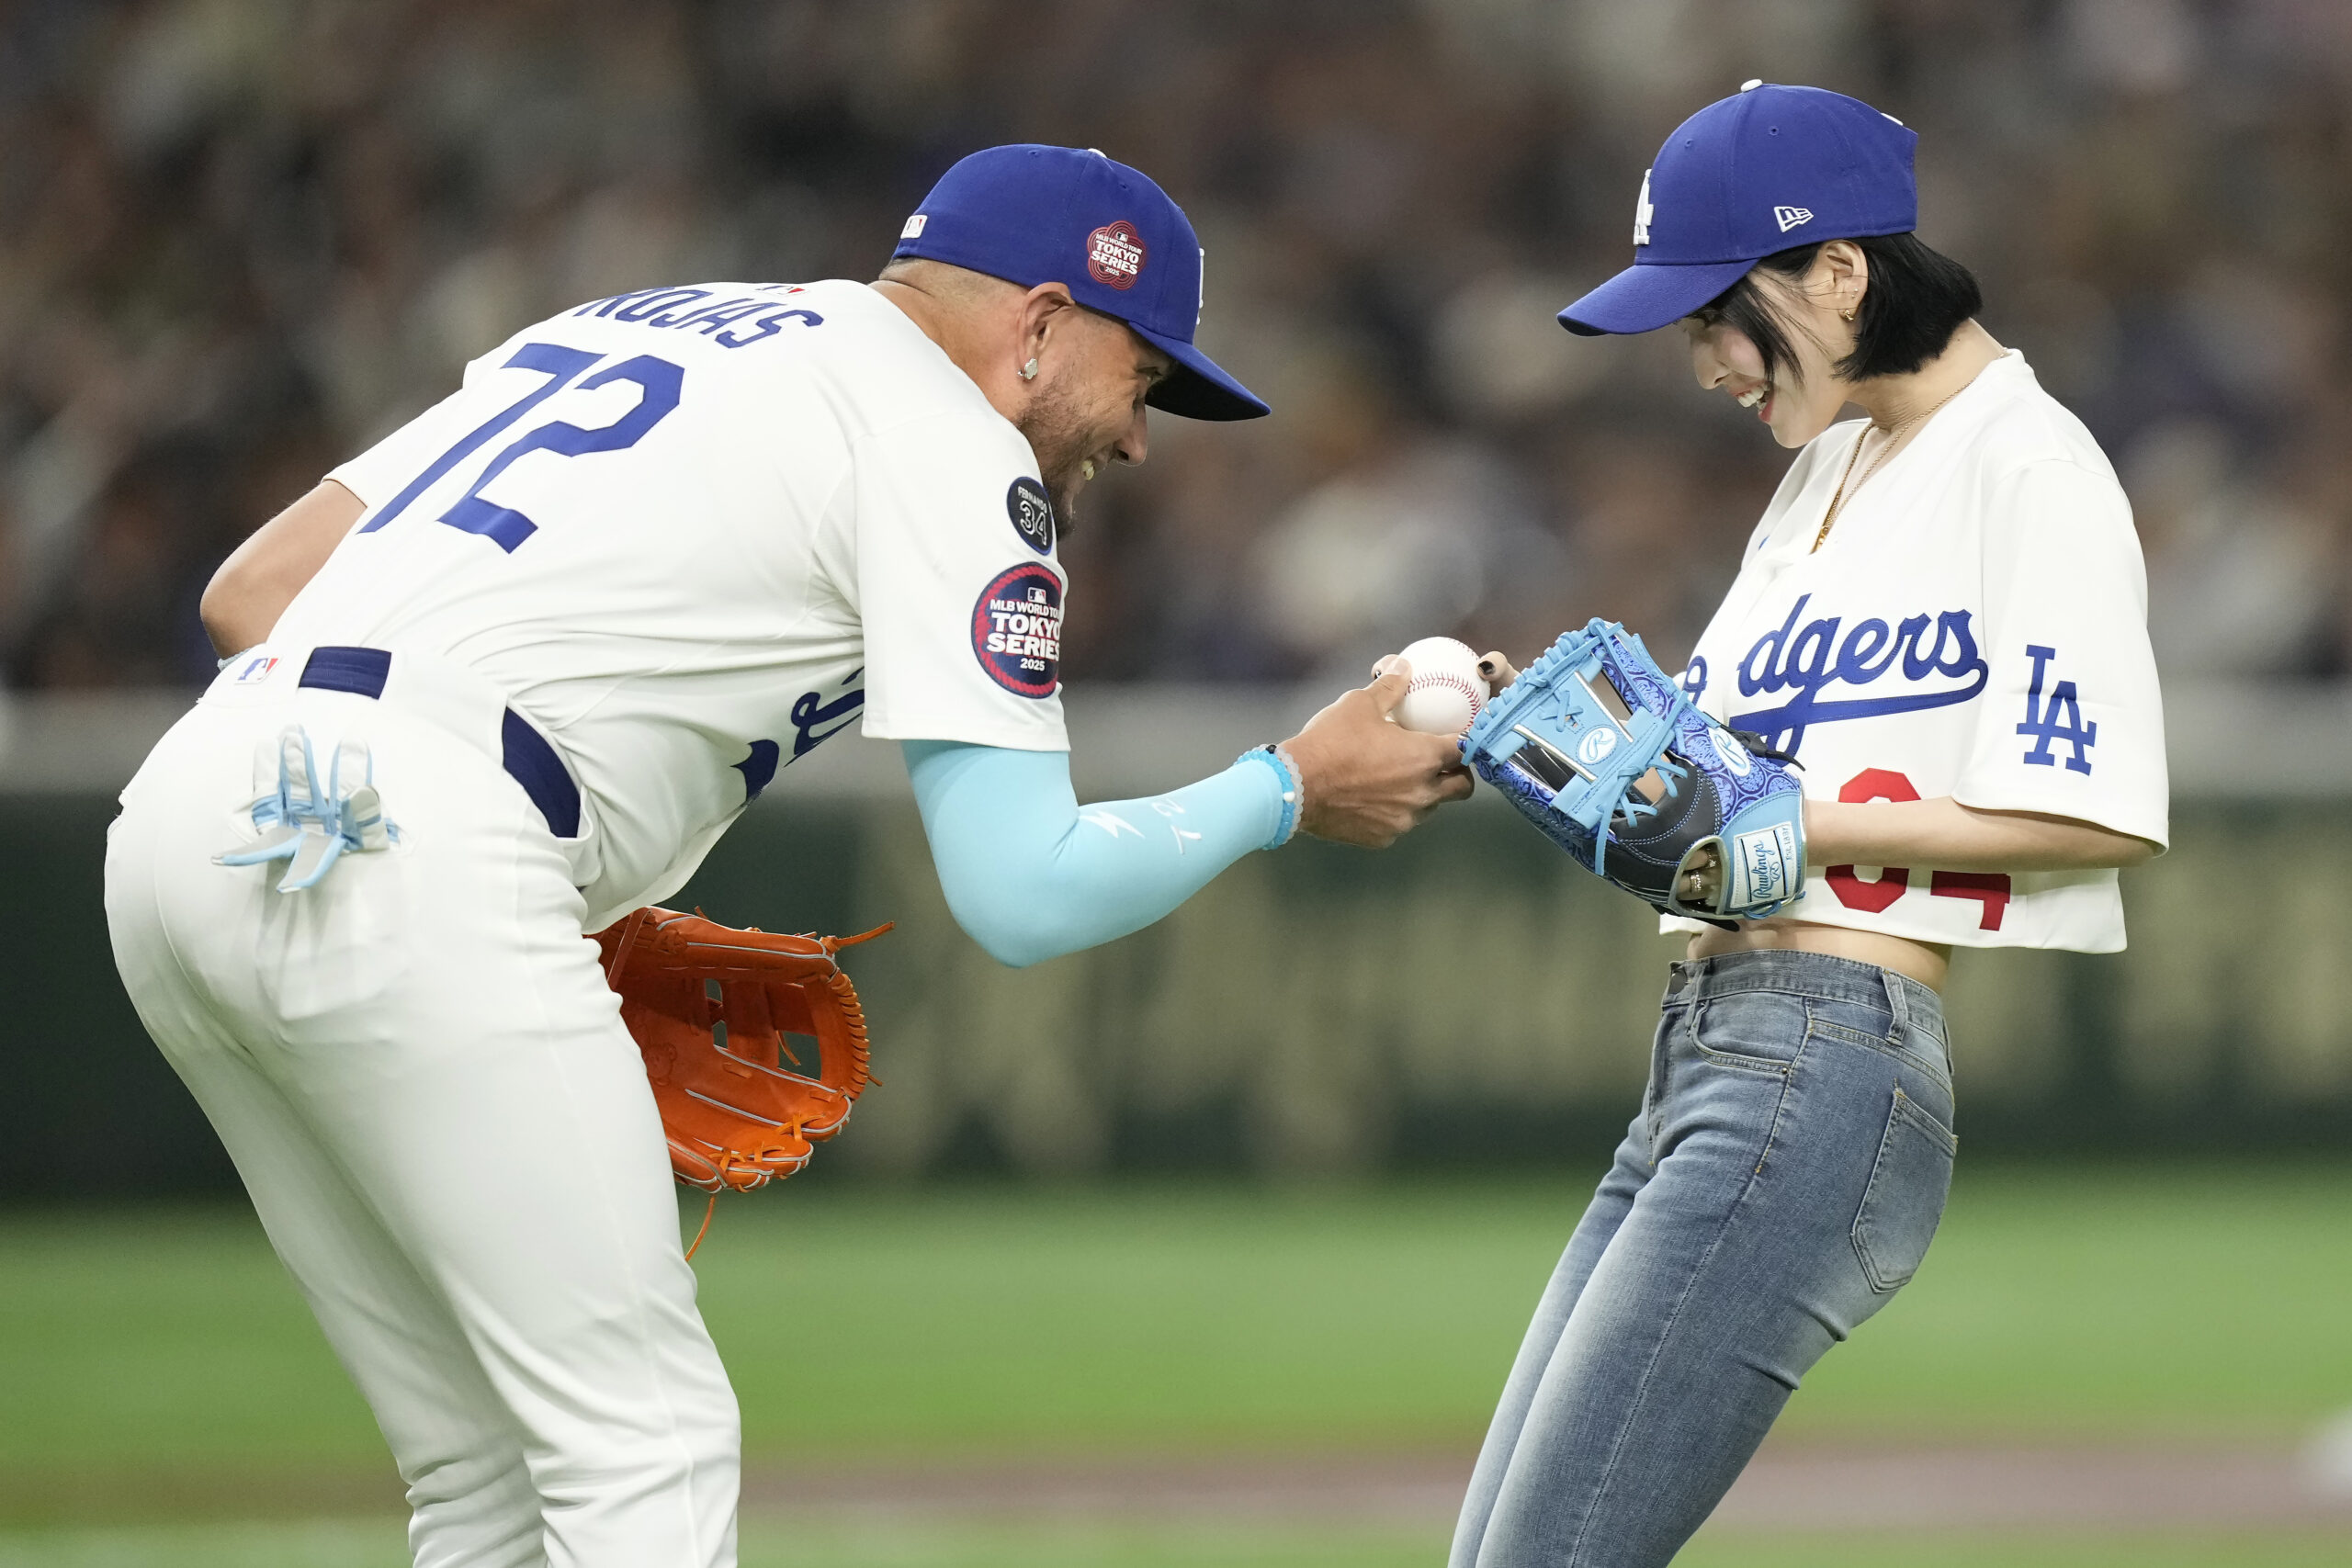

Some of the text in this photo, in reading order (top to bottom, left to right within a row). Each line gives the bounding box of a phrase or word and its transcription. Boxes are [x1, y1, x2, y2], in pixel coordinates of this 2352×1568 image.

[1096, 240, 1139, 264] TOKYO
[1109, 238, 1129, 249] WORLD
[1091, 250, 1138, 275] SERIES
[1105, 266, 1120, 276] 2025
[356, 343, 685, 554] 72
[1020, 500, 1046, 546] 34
[989, 599, 1059, 619] MLB WORLD TO
[991, 612, 1060, 641] TOKYO
[987, 632, 1060, 661] SERIES
[1020, 658, 1046, 671] 2025
[2016, 644, 2098, 776] LA
[1750, 840, 1776, 898] Rawlings
